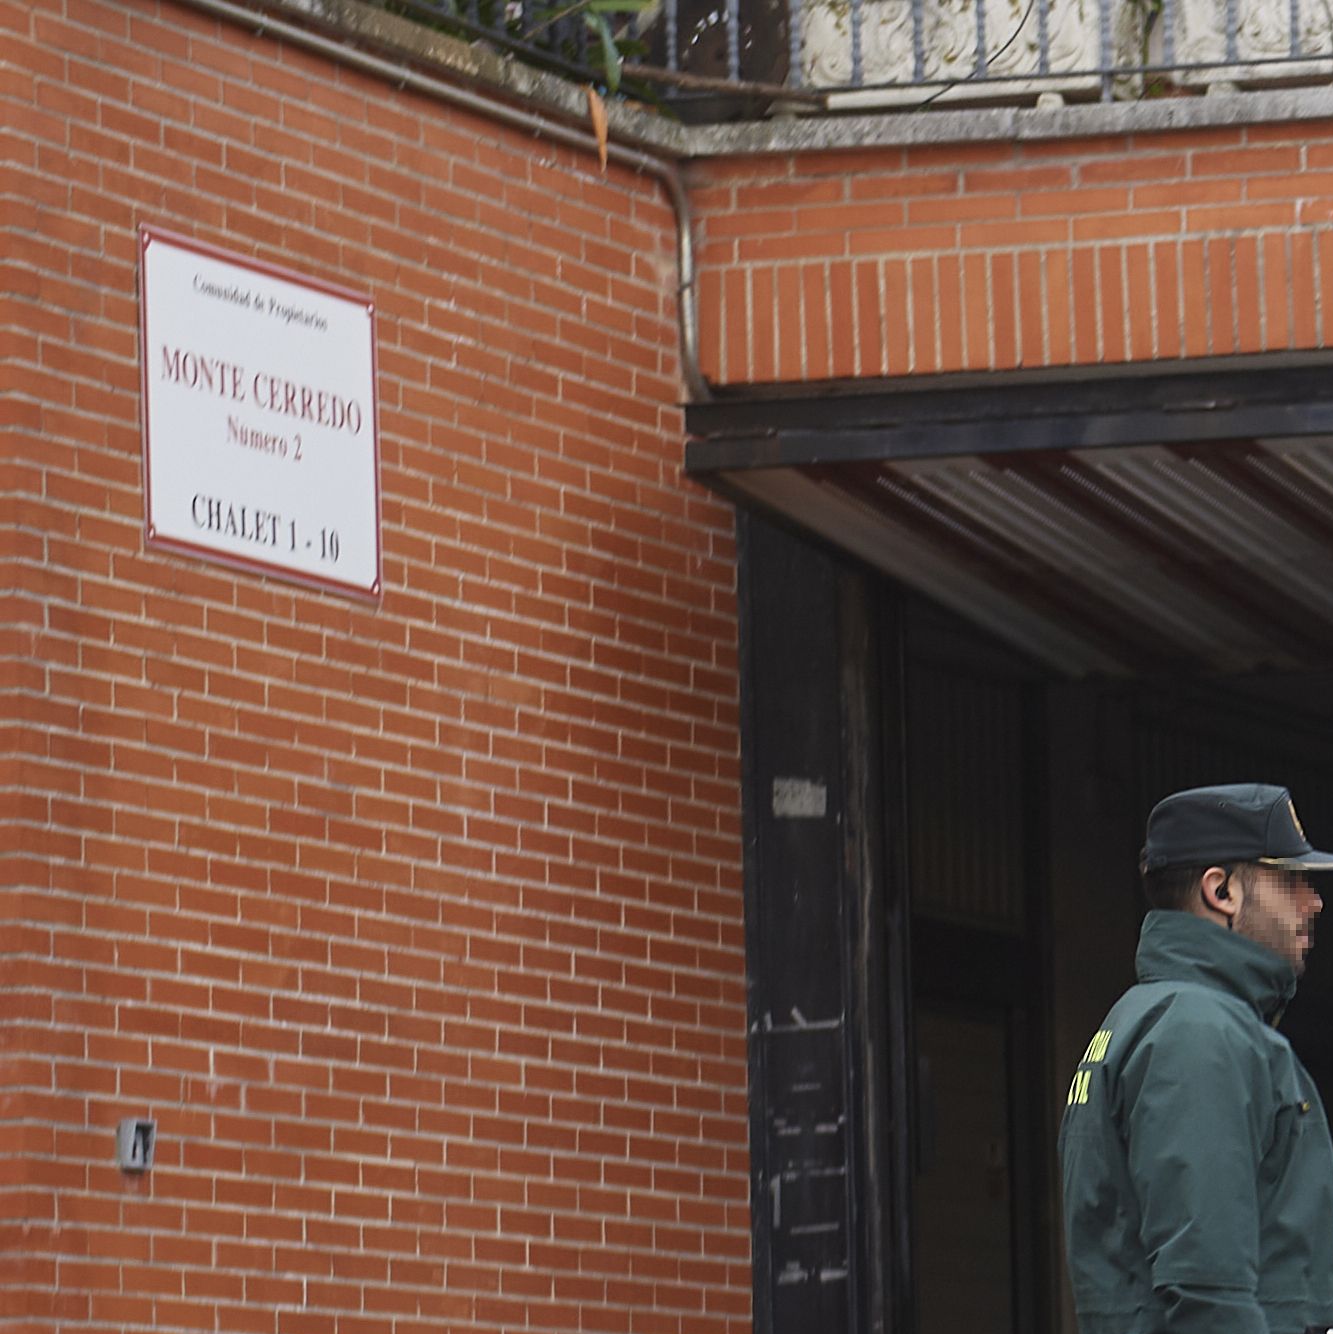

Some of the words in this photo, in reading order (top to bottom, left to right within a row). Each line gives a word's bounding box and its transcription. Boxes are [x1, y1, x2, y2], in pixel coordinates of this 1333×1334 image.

[161, 346, 247, 402] MONTE
[253, 372, 362, 436] CERREDO
[293, 432, 303, 461] 2
[192, 492, 281, 547] CHALET
[289, 521, 297, 552] 1
[319, 527, 340, 563] 10
